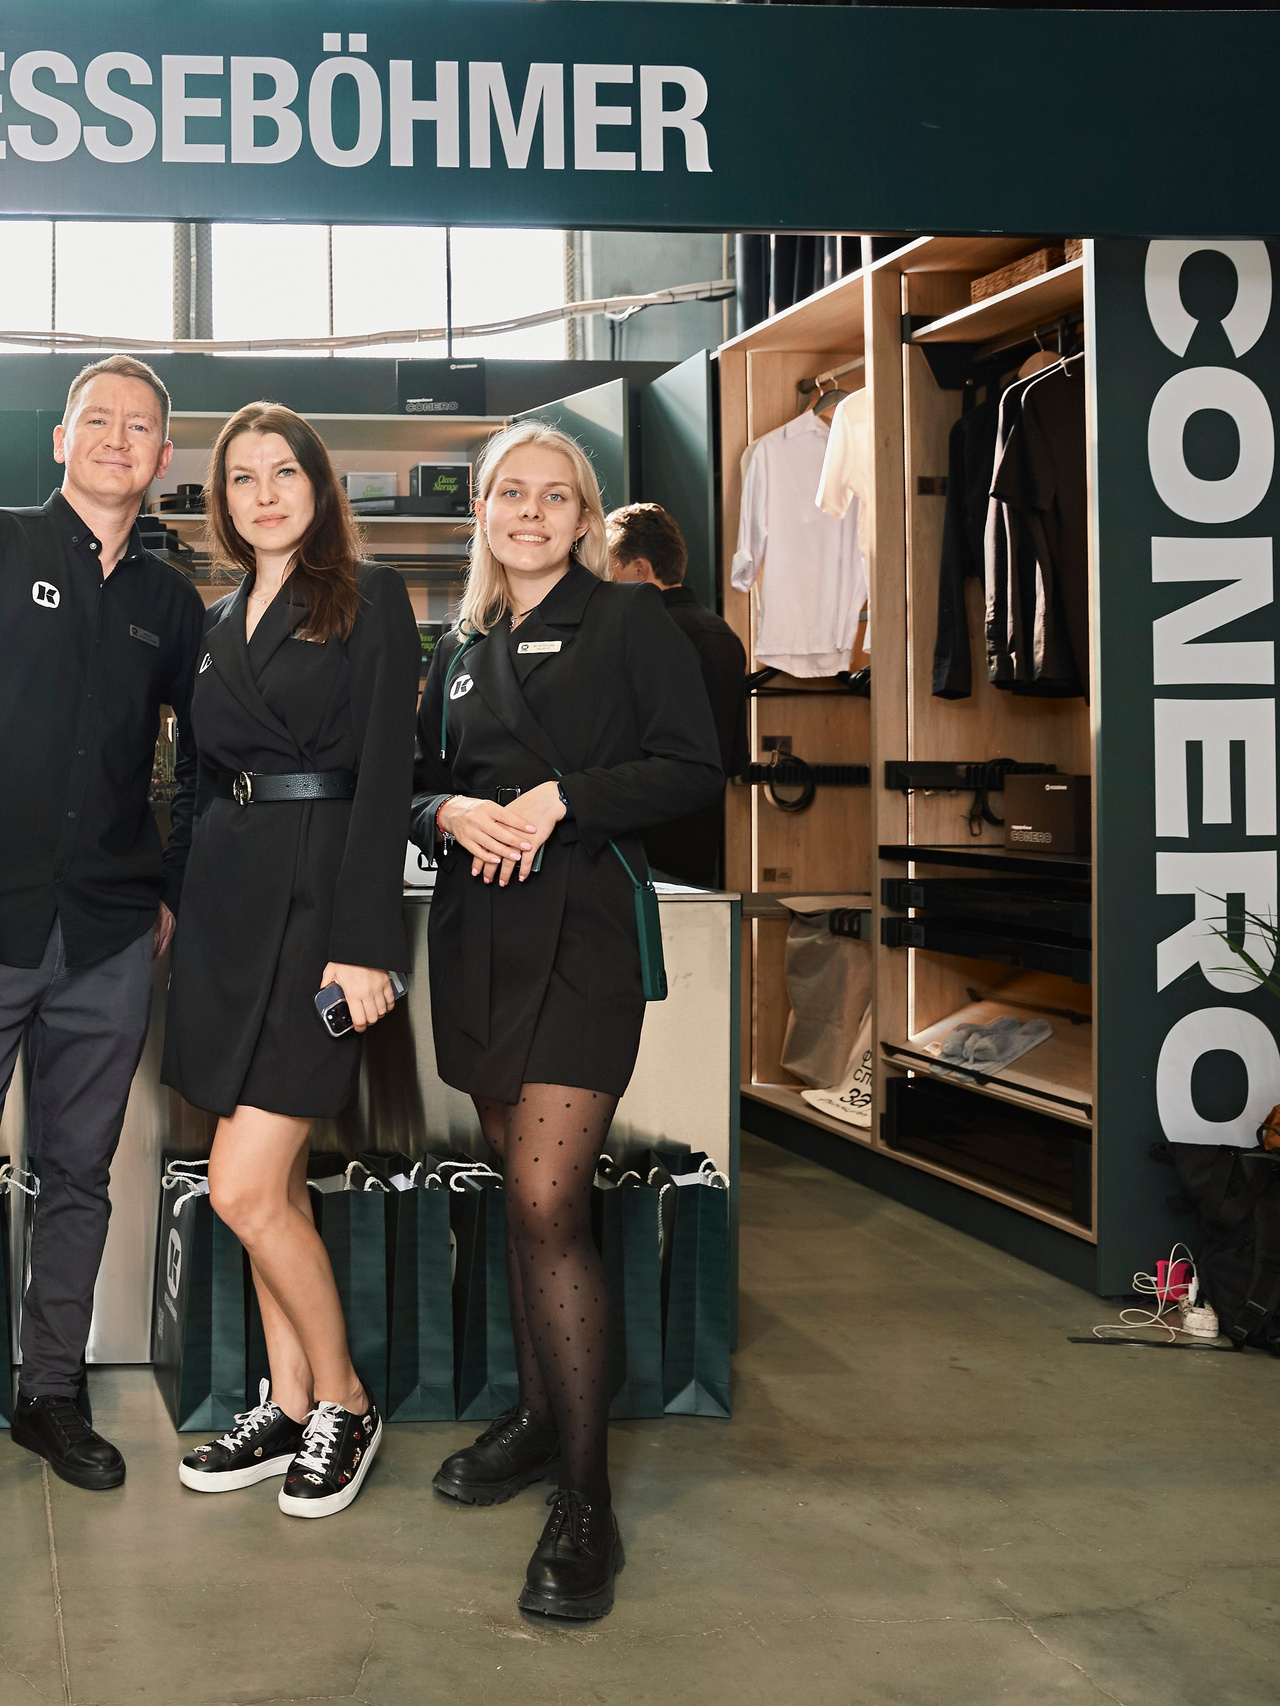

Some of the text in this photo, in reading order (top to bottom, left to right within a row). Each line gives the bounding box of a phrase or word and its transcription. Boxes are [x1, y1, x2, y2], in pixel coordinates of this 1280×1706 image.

[406, 401, 458, 412] CONERO
[437, 475, 458, 484] Clever
[433, 483, 459, 494] Storage
[1144, 239, 1280, 1147] CONERO
[1010, 830, 1052, 843] CONERO
